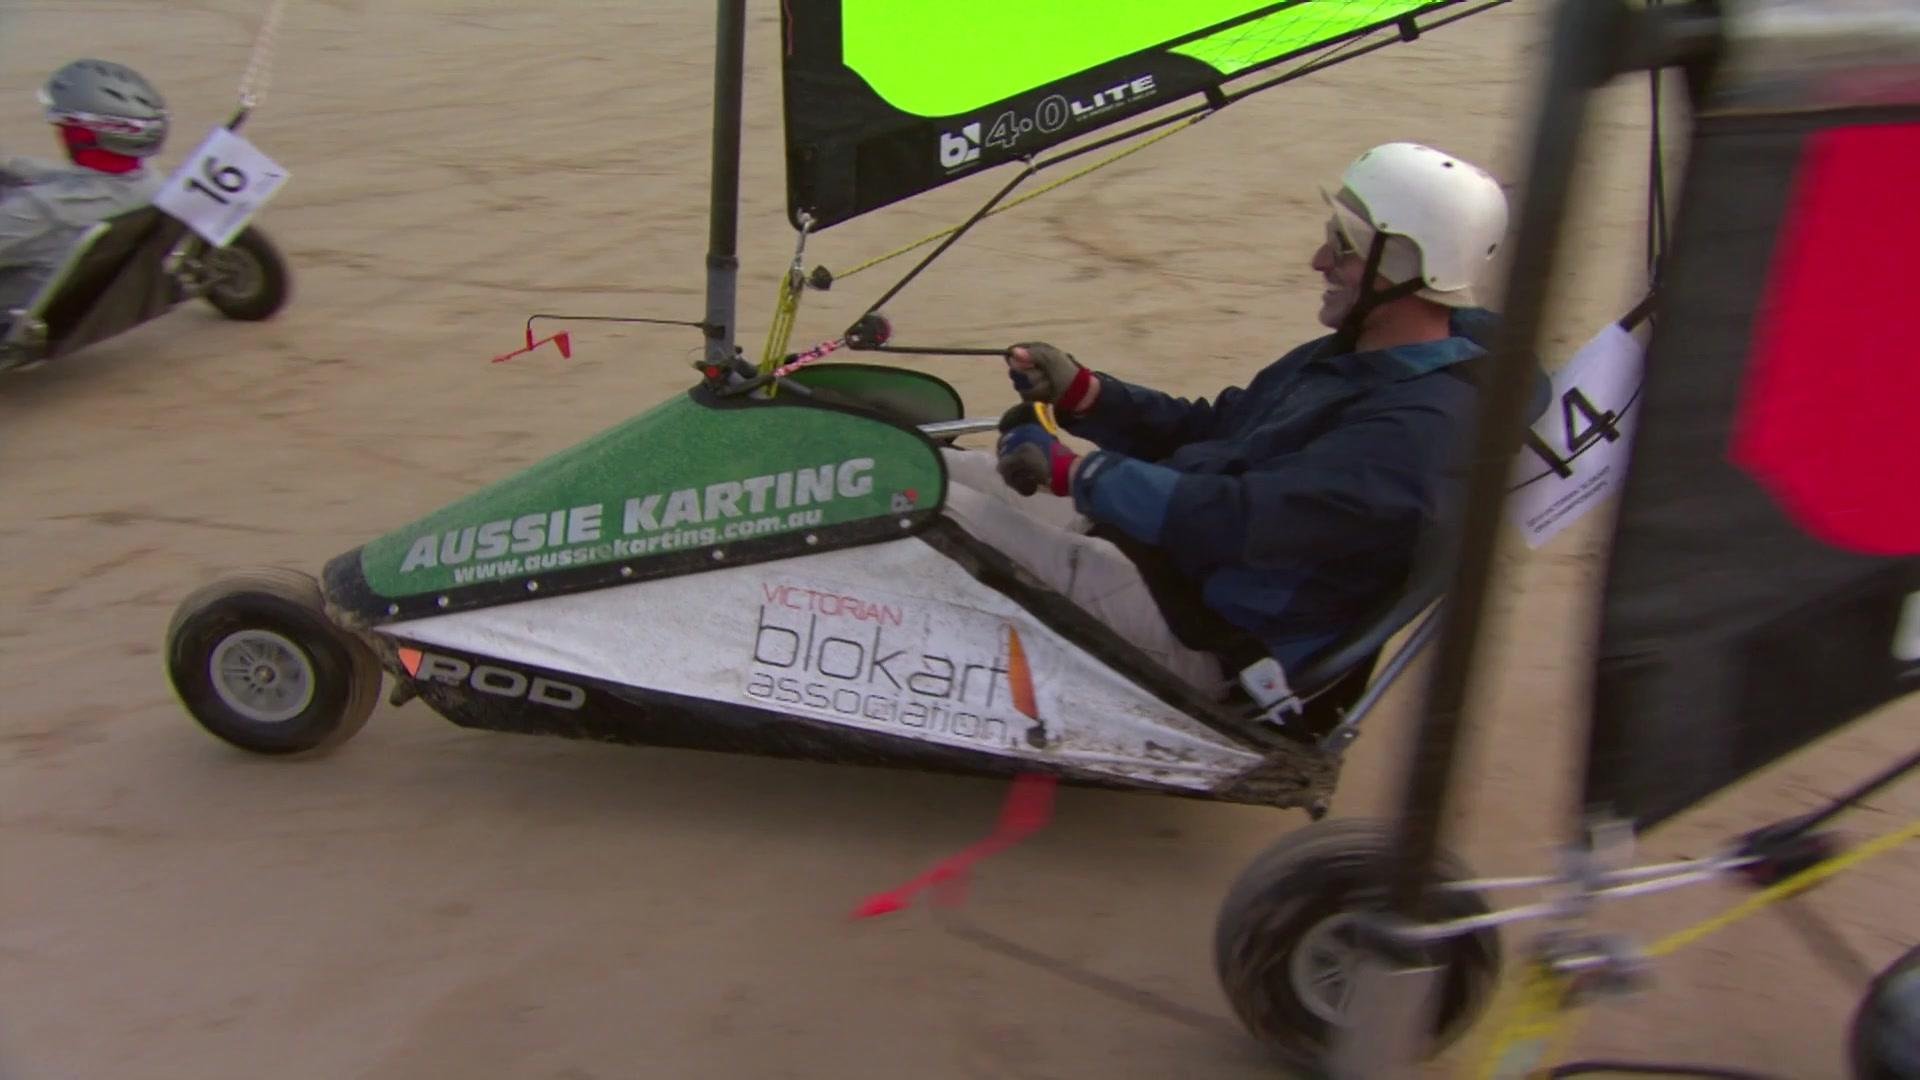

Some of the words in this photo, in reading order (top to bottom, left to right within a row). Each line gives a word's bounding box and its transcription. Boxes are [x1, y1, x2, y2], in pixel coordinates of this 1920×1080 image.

[1071, 75, 1156, 116] LITE
[183, 156, 248, 205] 16
[1523, 387, 1620, 479] 14
[400, 504, 603, 572] AUSSIE
[622, 457, 876, 535] KARTING
[453, 508, 823, 584] www.aussiekarting.com.au
[762, 583, 903, 627] VICTORIAN
[415, 652, 587, 710] POD
[753, 605, 1012, 707] blokart
[746, 672, 1008, 747] association
